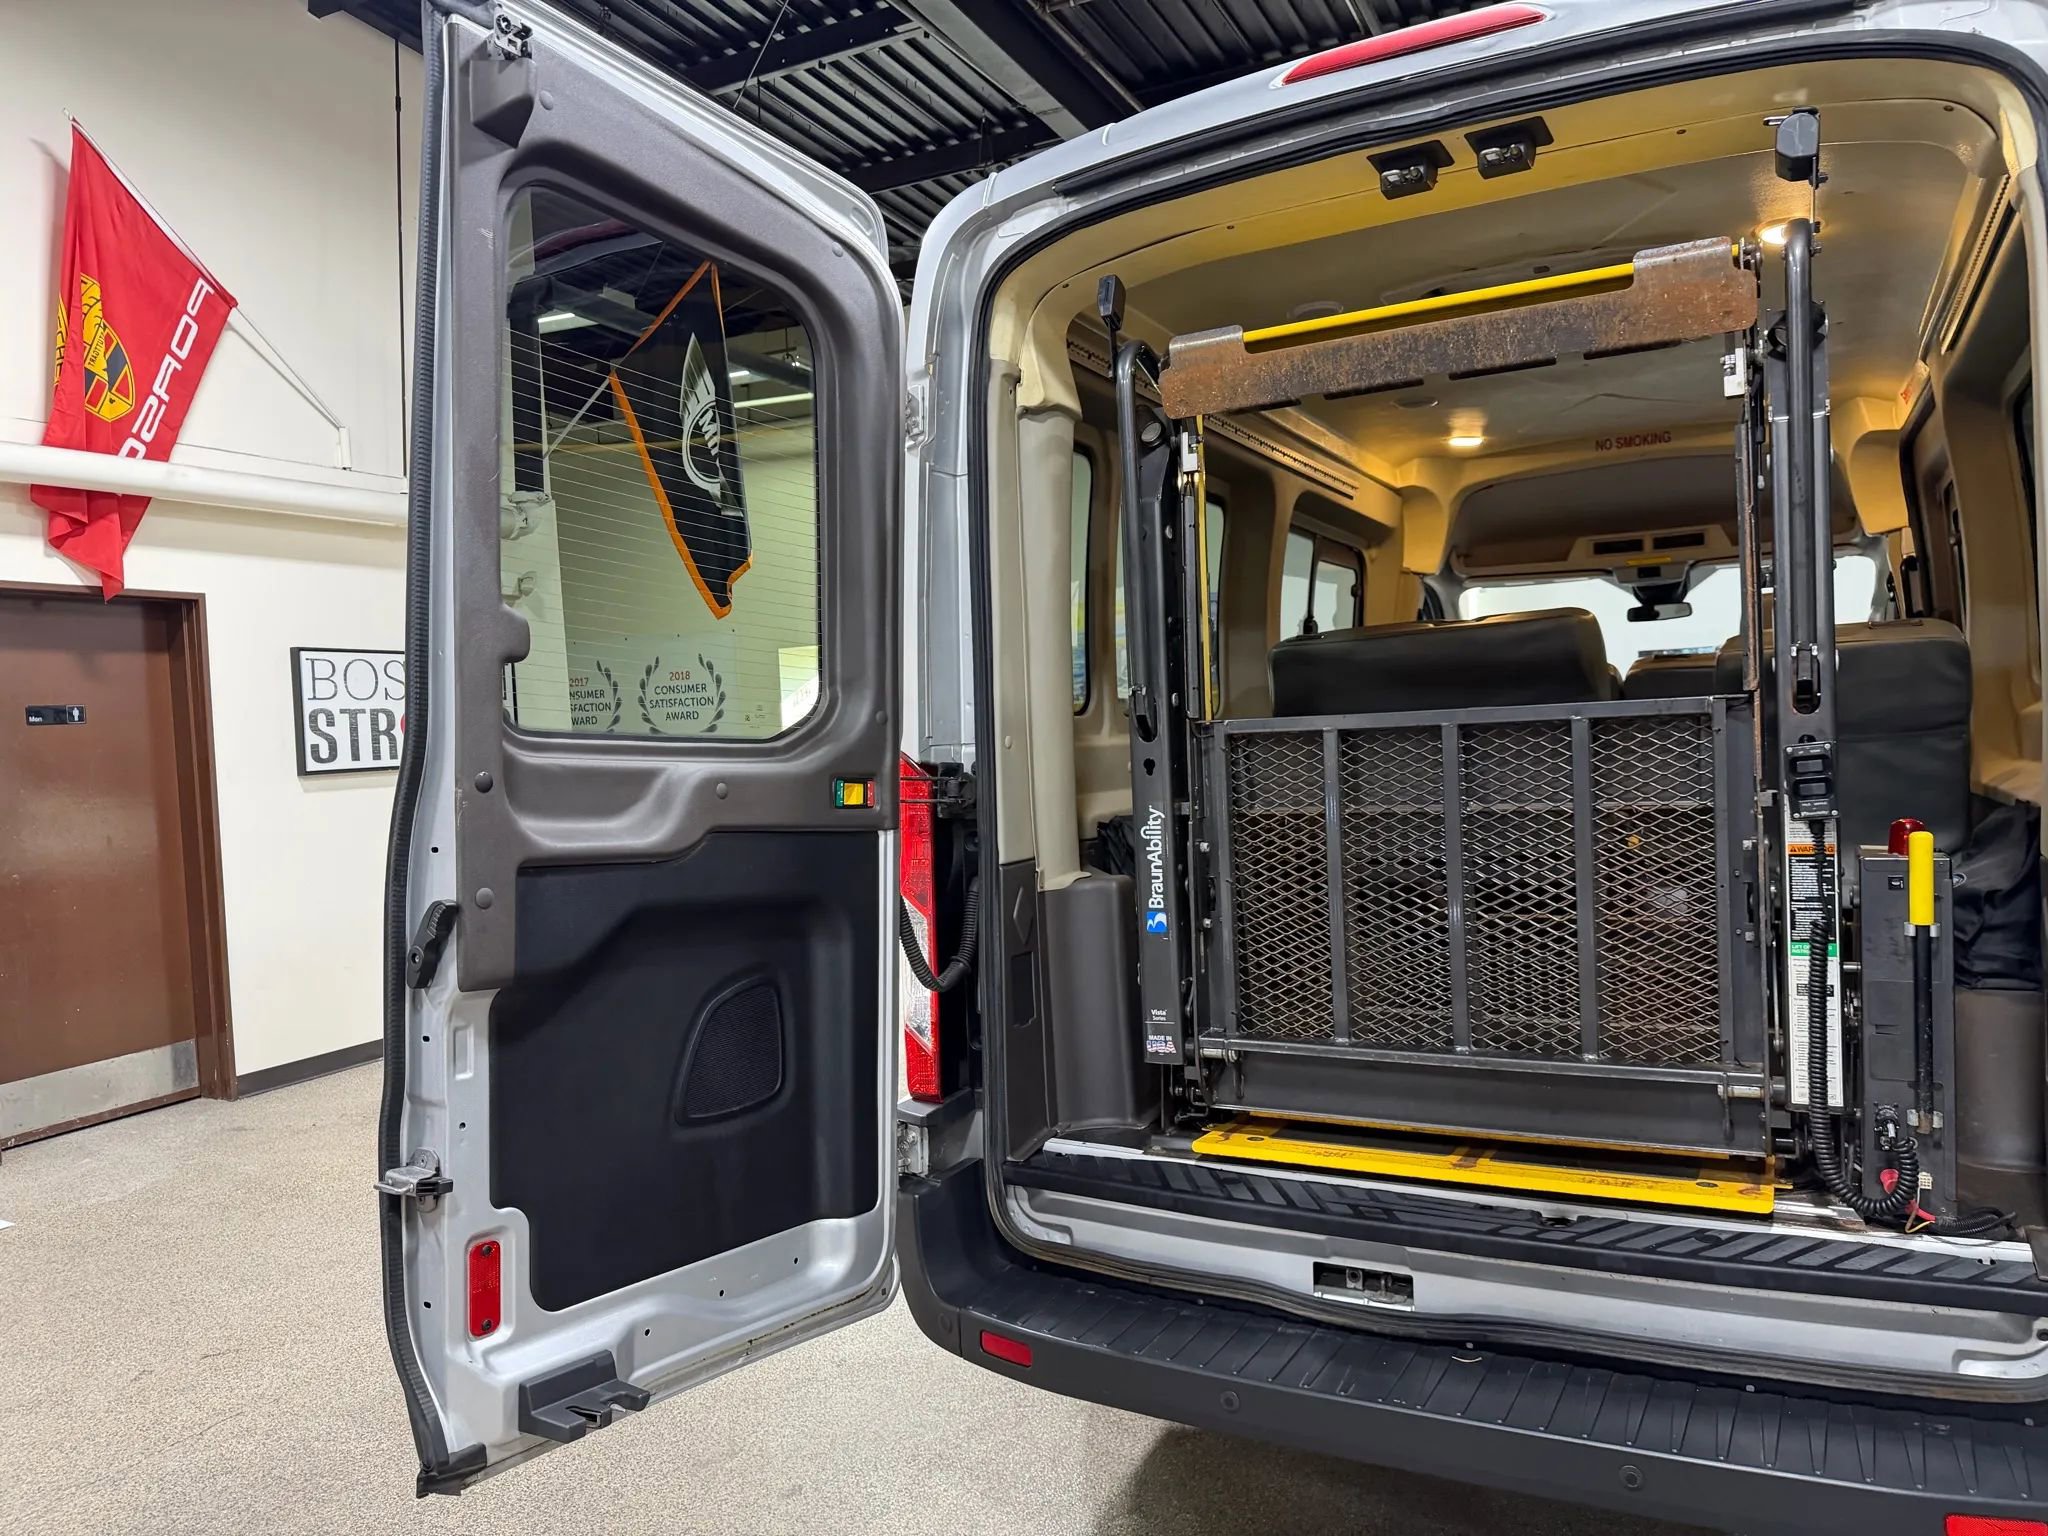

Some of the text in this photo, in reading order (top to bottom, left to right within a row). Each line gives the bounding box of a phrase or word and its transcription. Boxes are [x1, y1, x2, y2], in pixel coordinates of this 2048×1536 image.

[1595, 430, 1672, 452] NO SMOKING
[305, 658, 405, 701] BOS
[568, 677, 589, 688] 2017
[669, 671, 691, 682] 2018
[654, 683, 708, 696] CONSUMER
[649, 696, 715, 709] SATISFACTION
[665, 710, 700, 722] AWARD
[1797, 845, 1834, 853] WARG
[1140, 806, 1166, 909] BraunAbility
[1146, 1040, 1176, 1053] USA
